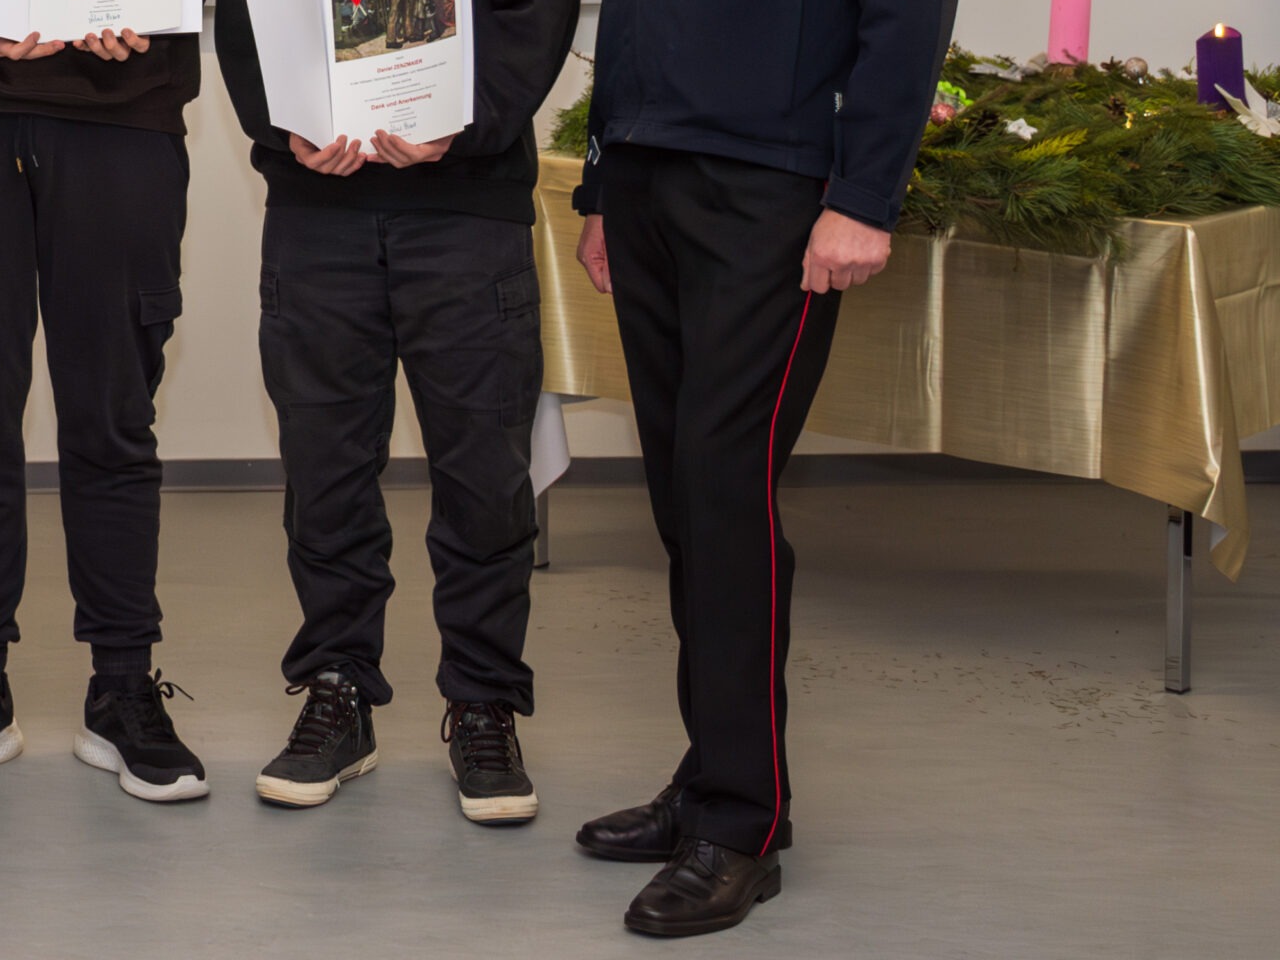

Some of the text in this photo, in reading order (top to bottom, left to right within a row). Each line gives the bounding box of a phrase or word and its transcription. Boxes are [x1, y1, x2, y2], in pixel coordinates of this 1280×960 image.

[371, 102, 385, 111] Dank
[386, 100, 397, 108] und
[398, 92, 432, 106] Anerkennung
